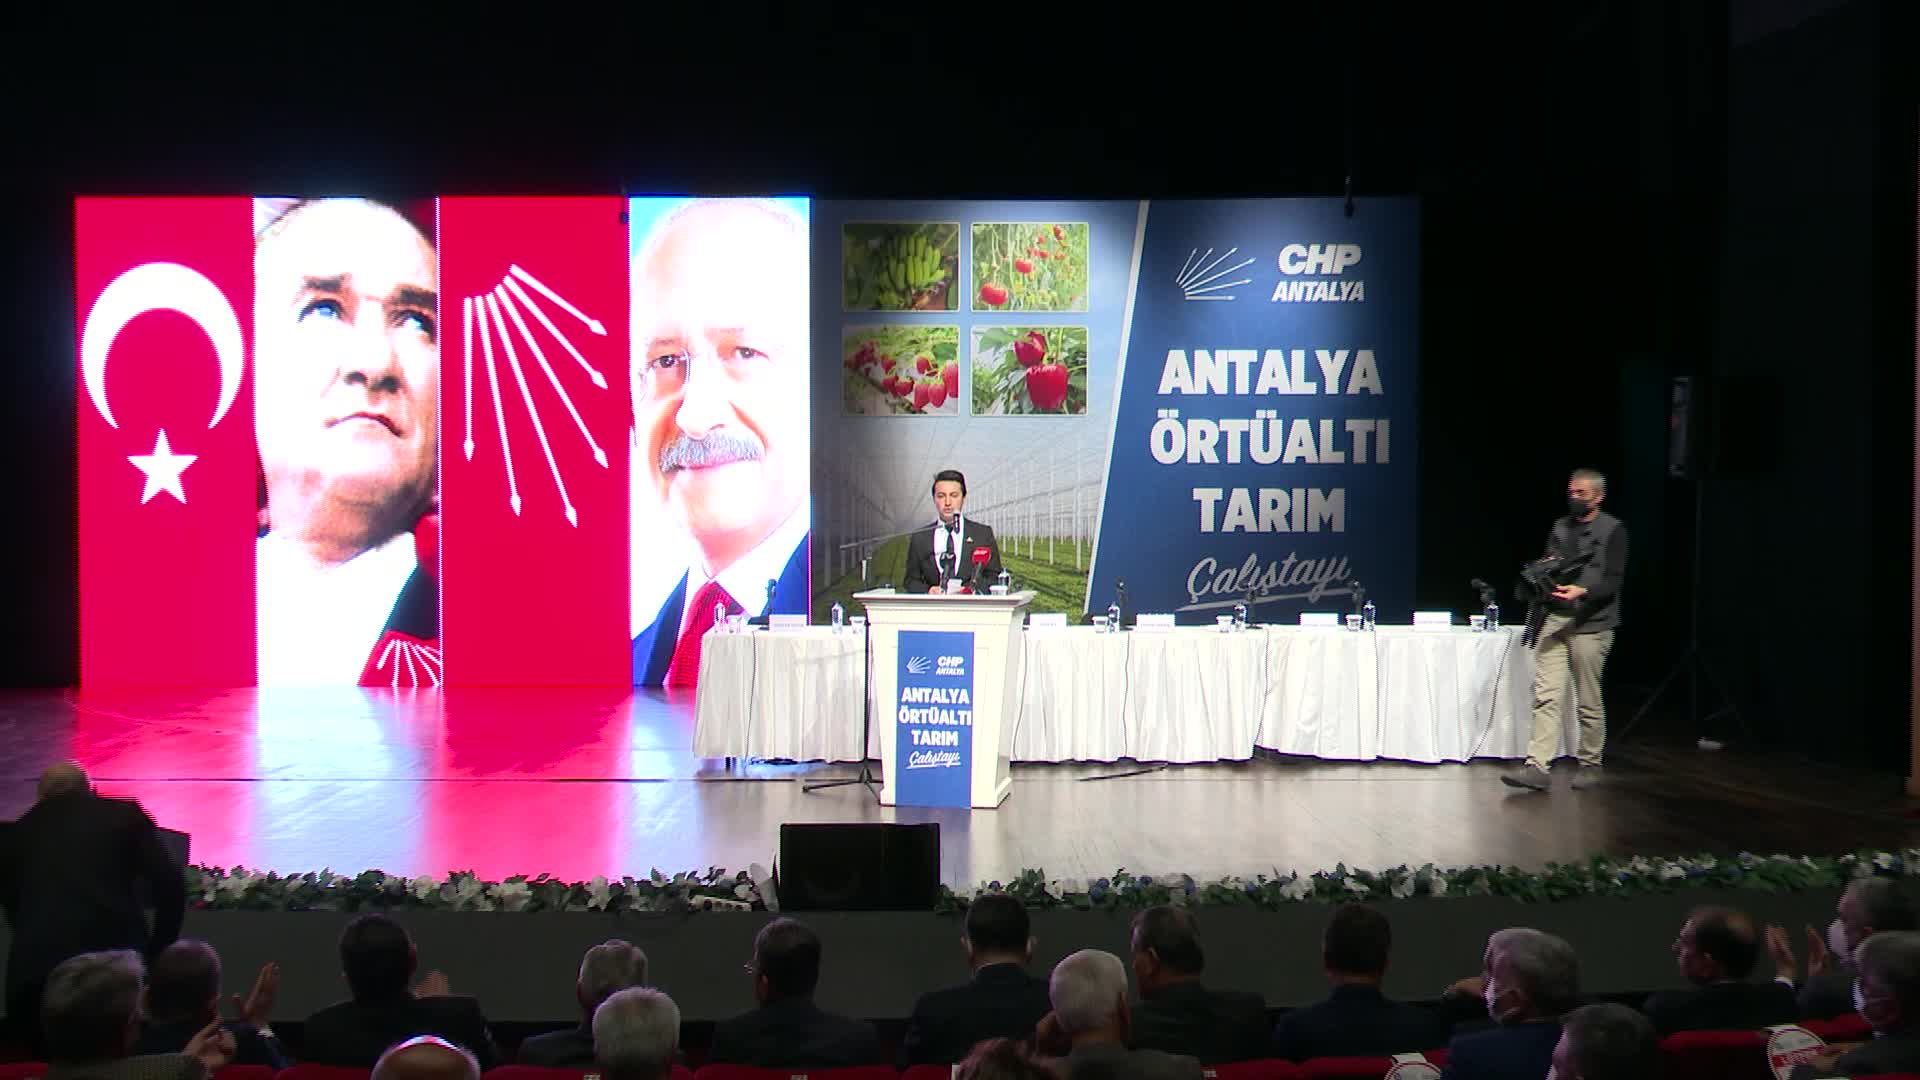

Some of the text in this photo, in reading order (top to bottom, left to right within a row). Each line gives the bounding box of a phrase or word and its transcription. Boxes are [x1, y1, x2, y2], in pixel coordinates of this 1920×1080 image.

[1278, 243, 1362, 275] CHP
[1271, 280, 1365, 302] ANTALYA
[1158, 349, 1383, 395] ANTALYA
[1150, 408, 1391, 464] ÖRTÜALTI
[1193, 488, 1345, 532] TARIM
[935, 668, 965, 676] ANTALYA
[937, 656, 964, 667] CHP
[901, 687, 970, 704] ANTALYA
[898, 705, 972, 726] ÖRTÜALTI
[911, 730, 959, 746] TARIM
